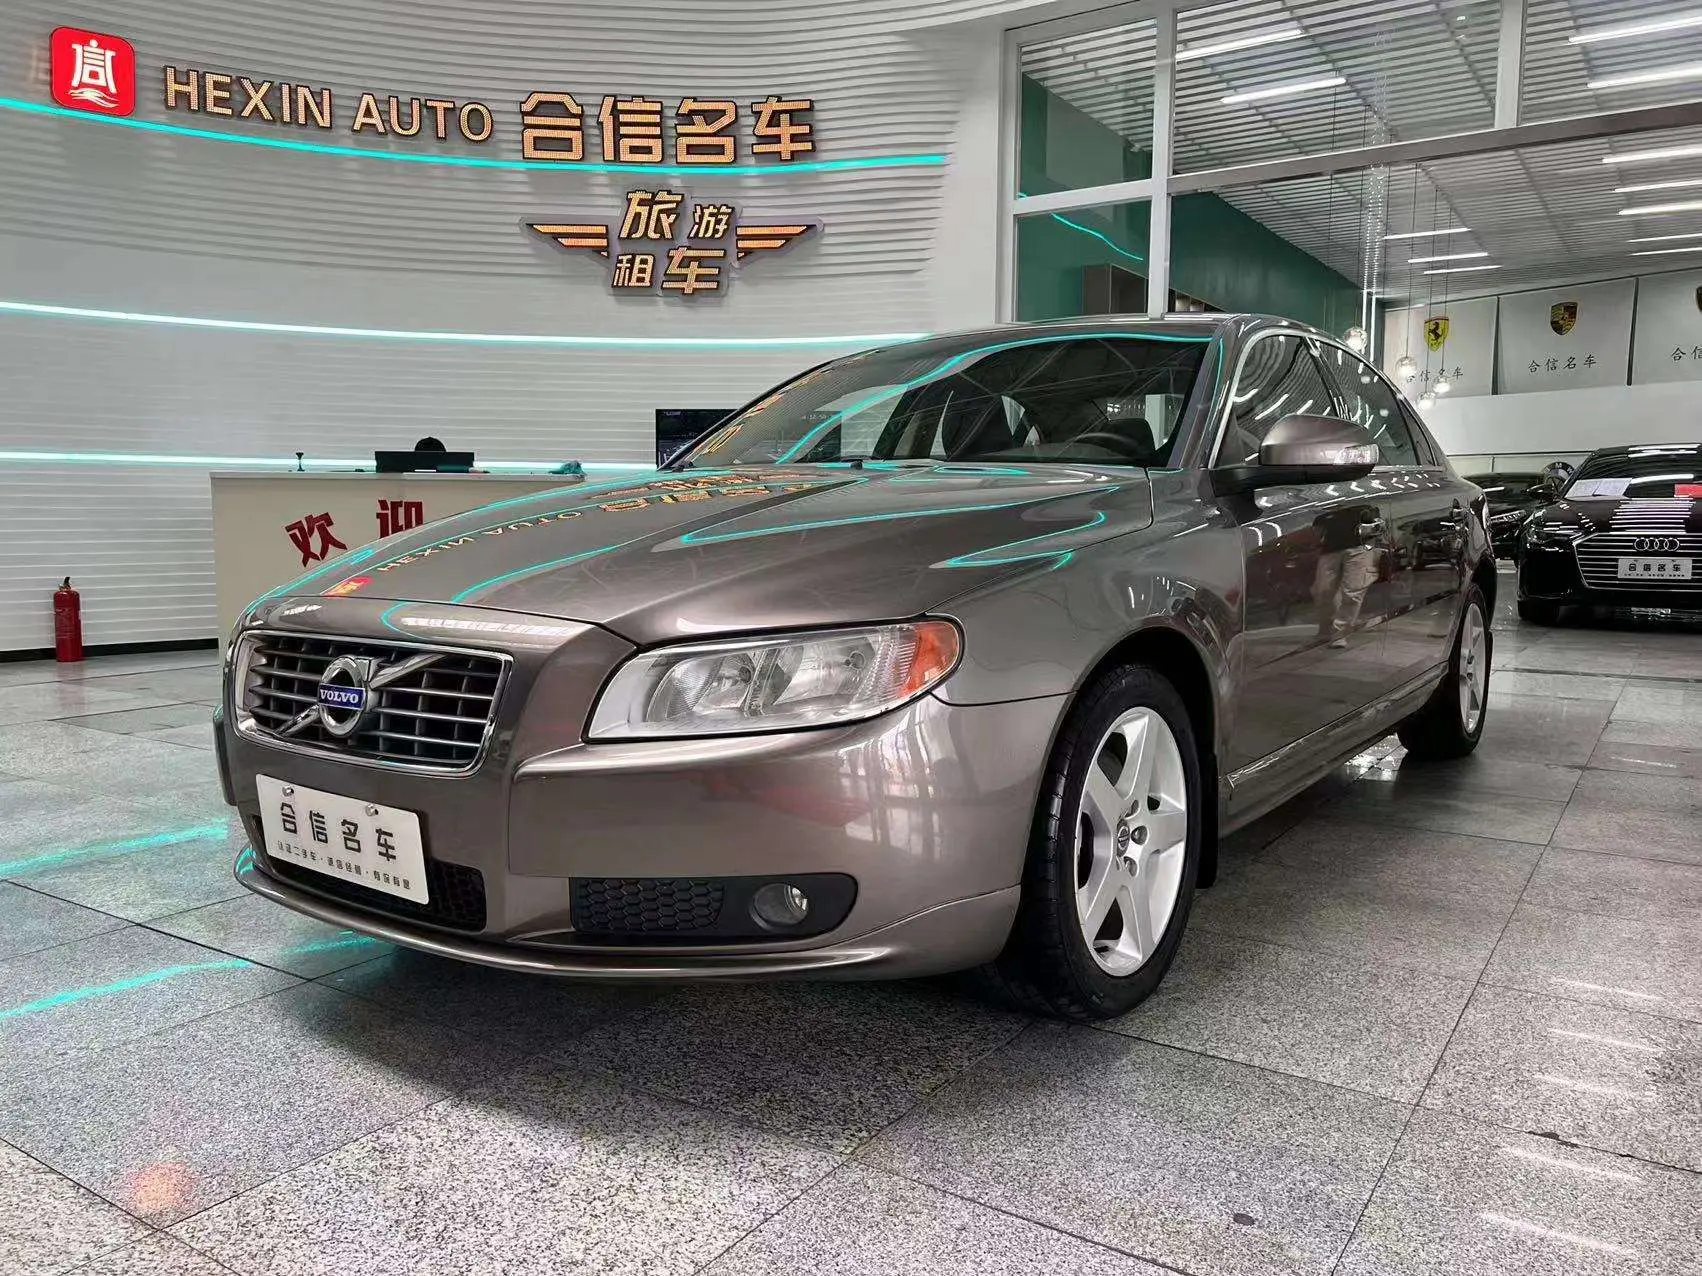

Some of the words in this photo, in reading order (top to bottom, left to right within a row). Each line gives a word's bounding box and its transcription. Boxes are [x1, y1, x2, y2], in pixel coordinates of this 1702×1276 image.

[164, 65, 333, 129] HEXIN
[351, 92, 496, 143] AUTO
[520, 91, 816, 164] 合信名车
[617, 189, 737, 240] 旅游
[611, 245, 727, 295] 租车
[1528, 354, 1597, 373] 合信名车
[319, 688, 360, 704] VOLVO
[280, 802, 397, 862] 合信名车
